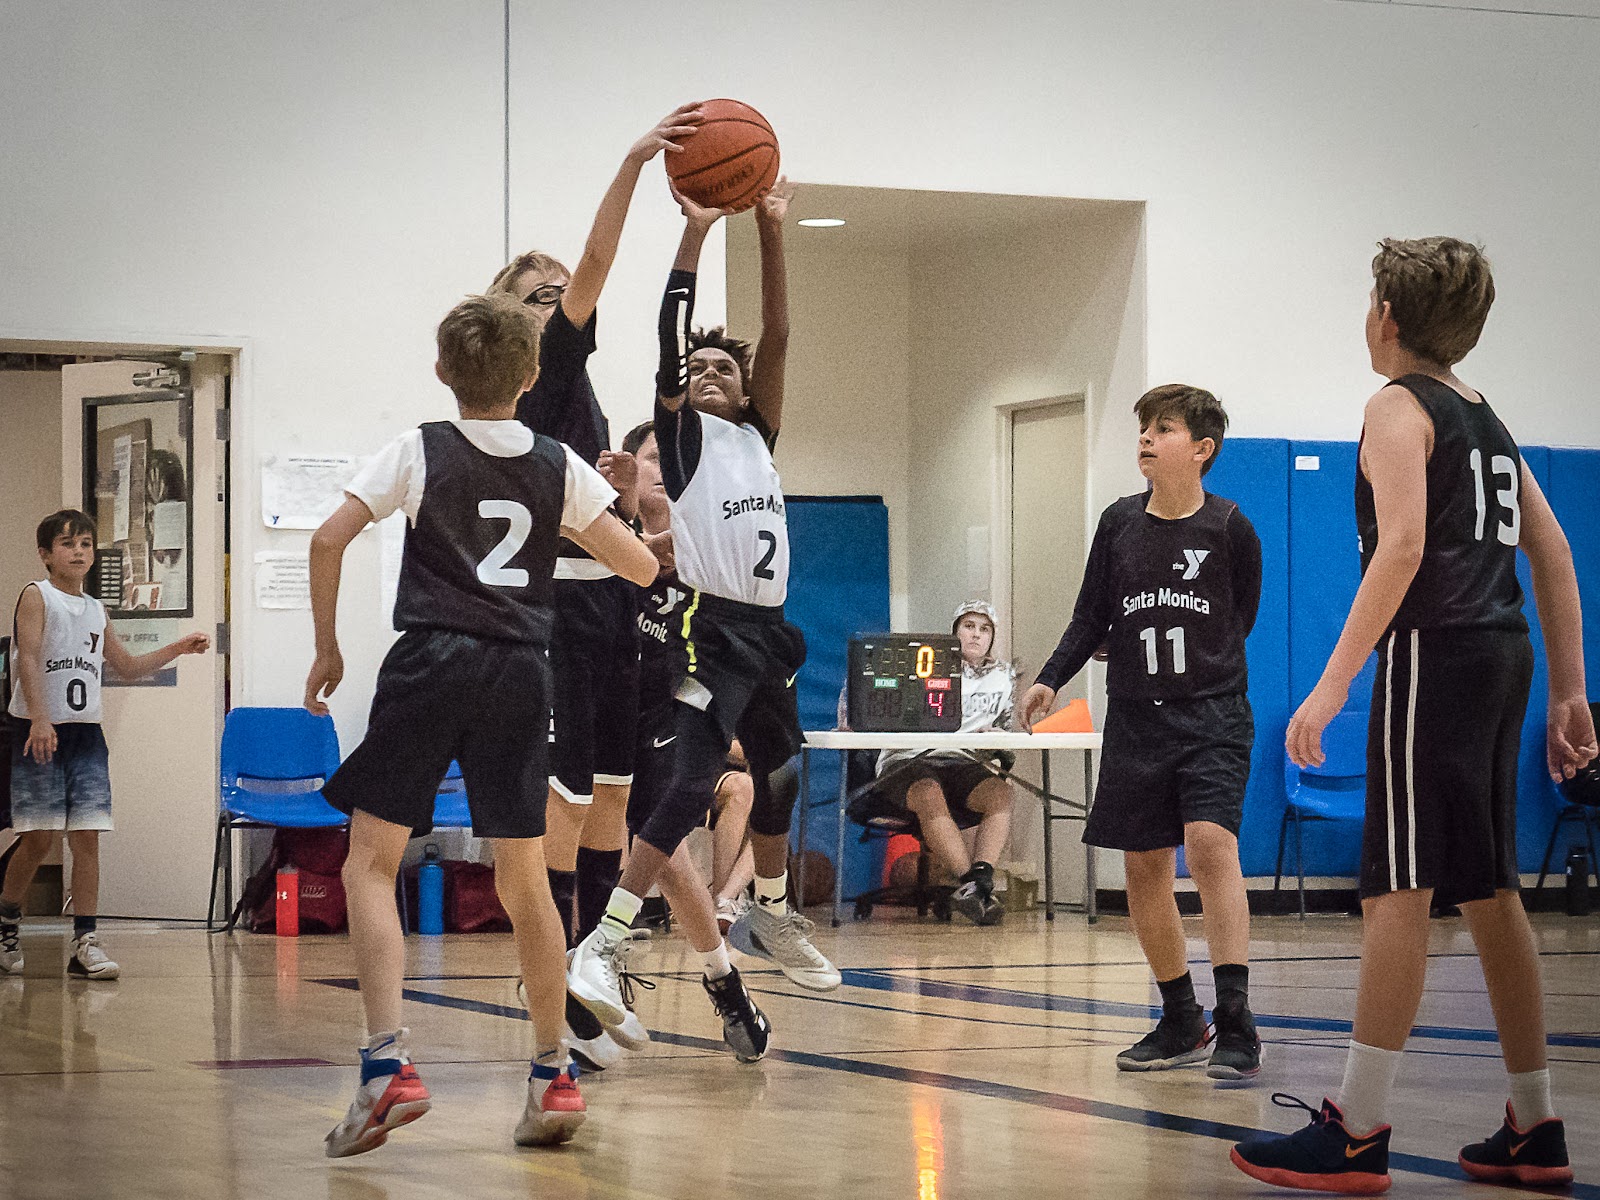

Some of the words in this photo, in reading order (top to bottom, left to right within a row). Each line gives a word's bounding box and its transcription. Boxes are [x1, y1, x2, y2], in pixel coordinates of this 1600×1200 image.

[722, 495, 765, 520] Santa
[1470, 448, 1521, 546] 13
[477, 499, 532, 588] 2
[753, 530, 777, 581] 2
[1122, 590, 1155, 616] Santa
[1157, 587, 1210, 615] Monica
[45, 656, 73, 673] Santa
[915, 645, 935, 679] 0
[1139, 626, 1186, 675] 11
[67, 678, 87, 711] 0
[928, 692, 944, 717] 4
